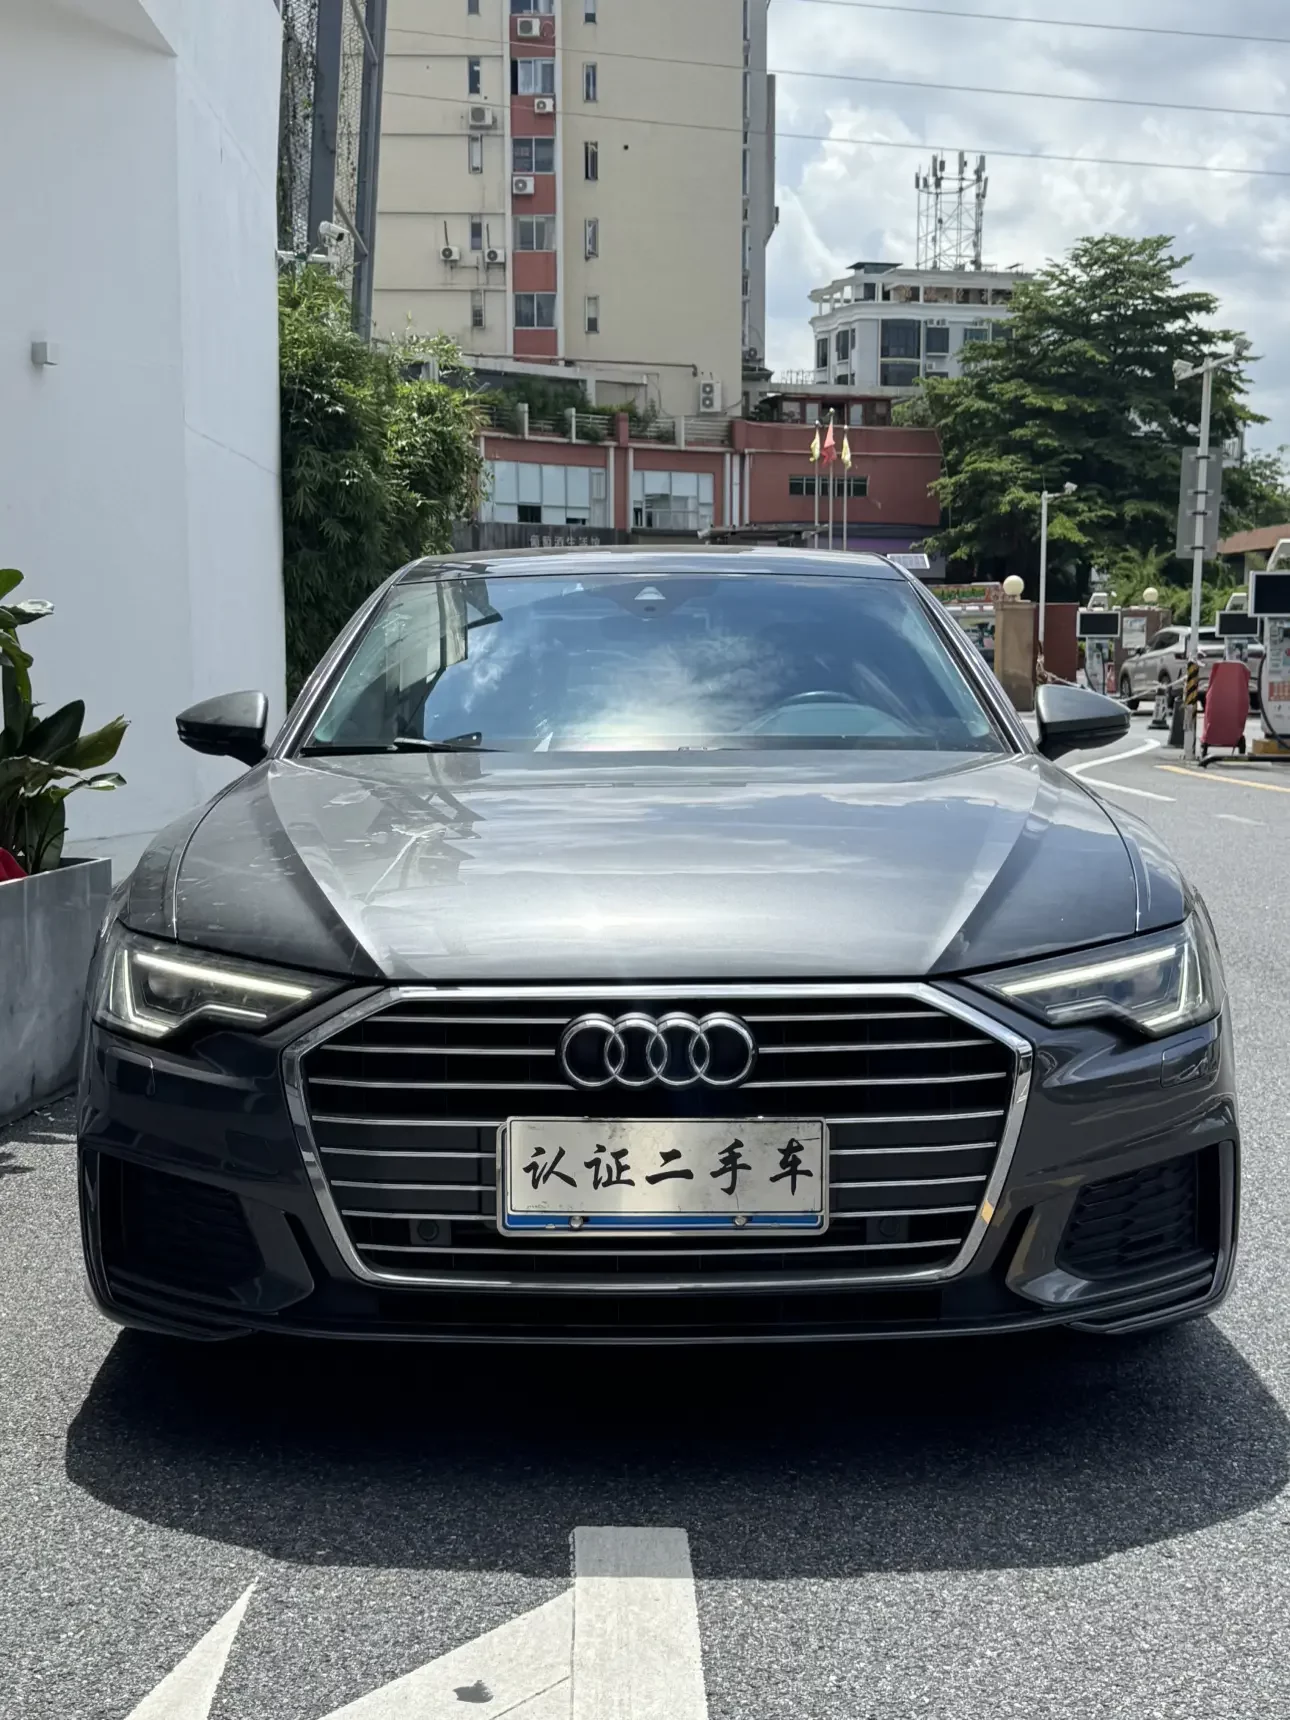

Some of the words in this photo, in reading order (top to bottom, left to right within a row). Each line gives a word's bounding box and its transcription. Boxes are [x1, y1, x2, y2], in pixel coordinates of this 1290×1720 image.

[523, 1138, 814, 1195] 认证二手车
